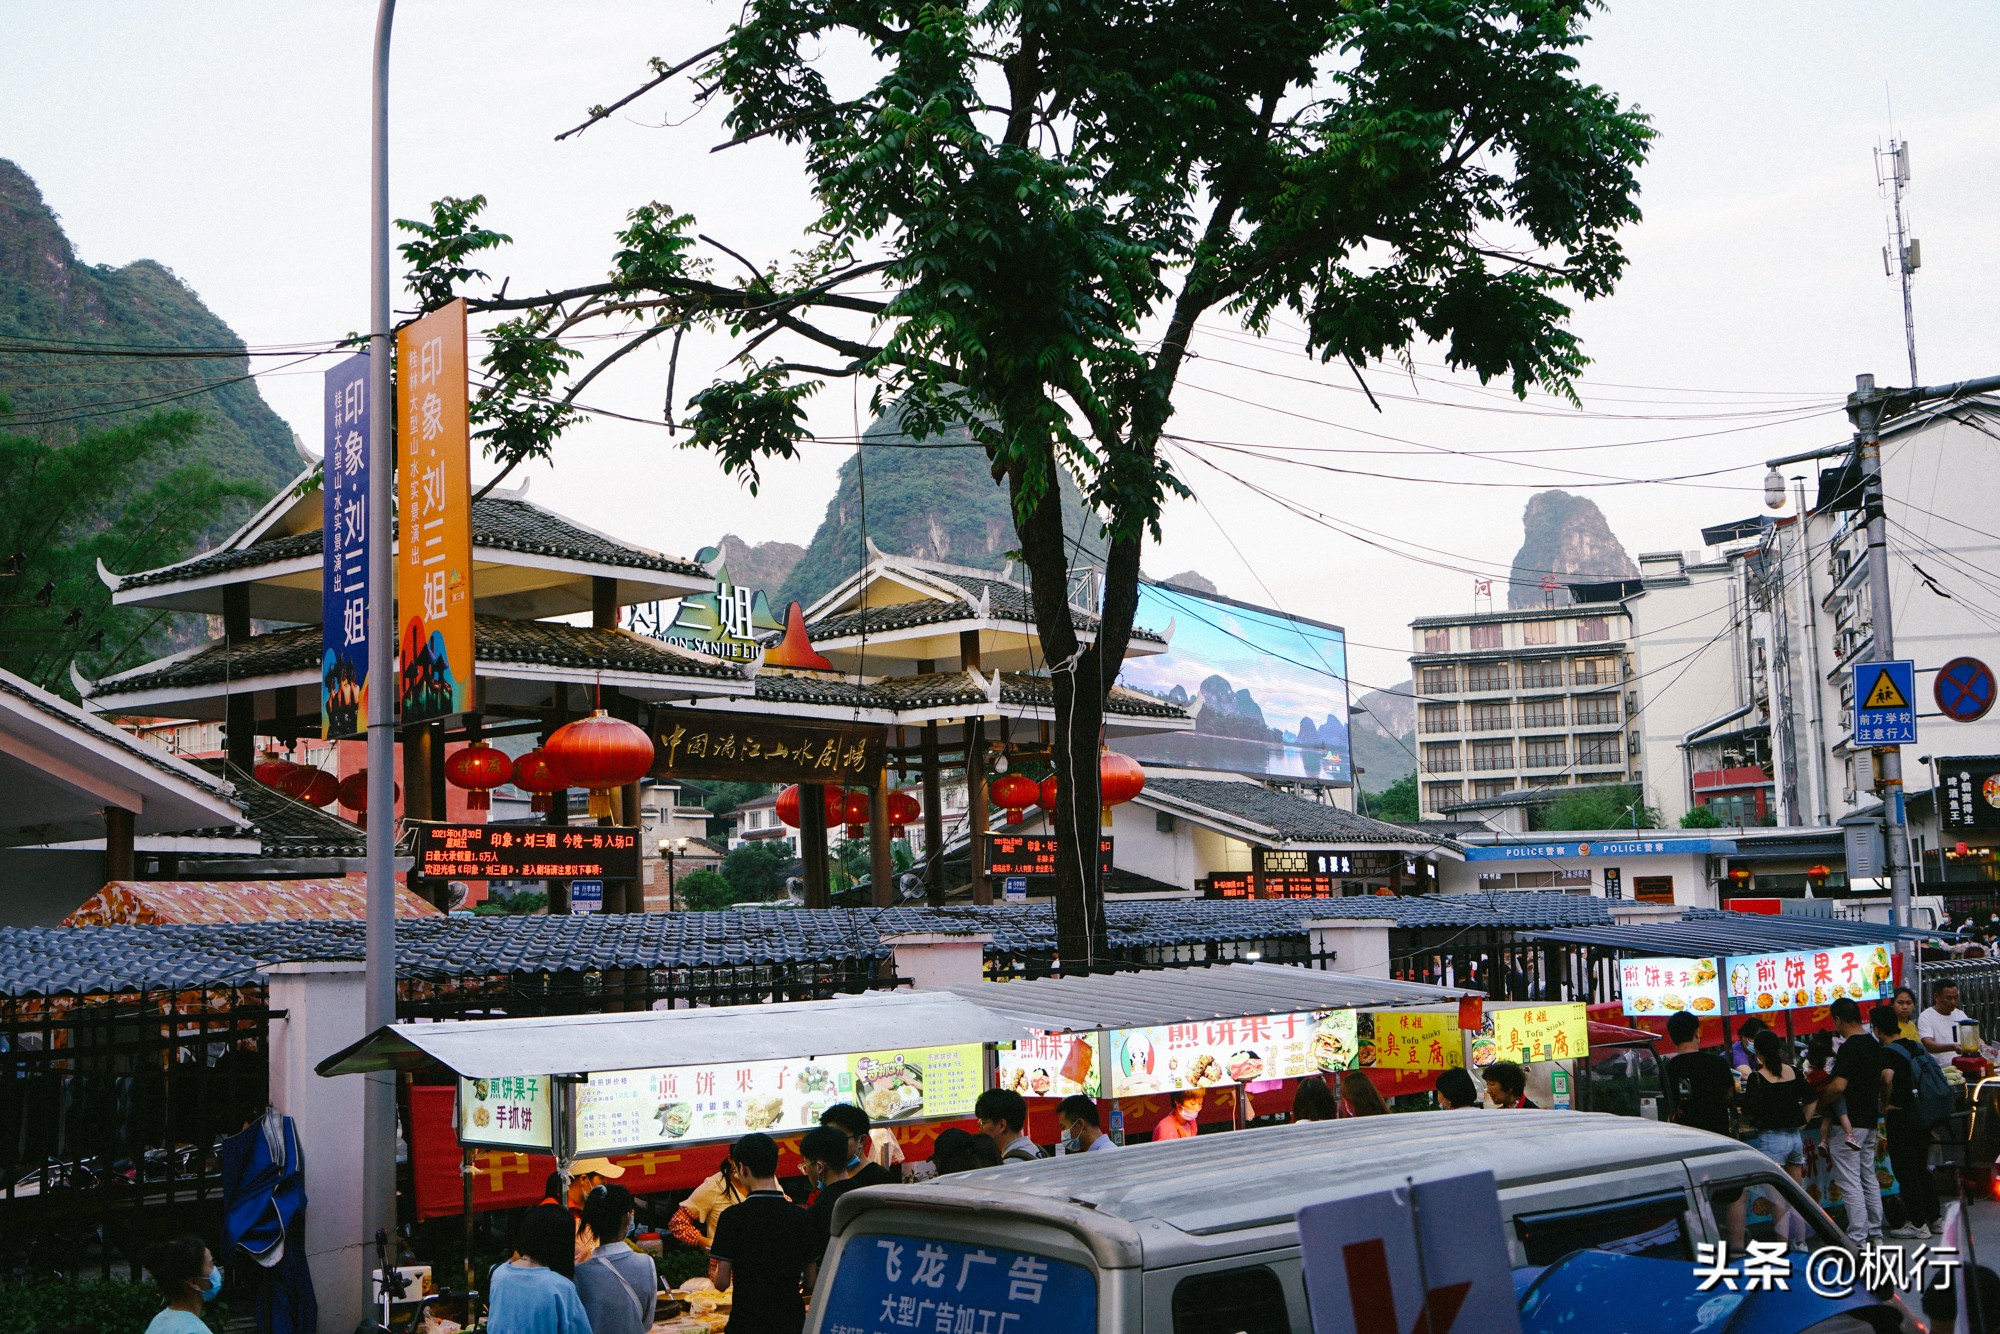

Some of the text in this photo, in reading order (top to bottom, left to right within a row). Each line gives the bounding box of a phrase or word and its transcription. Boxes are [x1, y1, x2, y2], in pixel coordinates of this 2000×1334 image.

[409, 350, 420, 565] 桂林大型山水实景演出
[333, 391, 343, 593] 桂林大型山水实景演出
[695, 637, 738, 658] SANJIE
[1859, 712, 1912, 726] 前方学校
[1860, 727, 1912, 740] 注意行人
[1947, 776, 1961, 820] 啤酒鱼王
[431, 829, 482, 839] 2021年04月30日
[562, 833, 603, 849] 今晚一场
[605, 835, 634, 849] 入场口
[1506, 846, 1566, 857] POLICE 警察
[1603, 843, 1665, 854] POLICE 警察
[1623, 964, 1690, 988] 煎饼果子
[1755, 951, 1859, 992] 煎饼果子
[1168, 1013, 1305, 1050] 煎饼果子
[1401, 1029, 1441, 1045] Tofu Stinky
[1525, 1020, 1566, 1038] Tofu Stinky
[1384, 1032, 1445, 1068] 臭豆腐
[1506, 1027, 1569, 1058] 臭豆腐
[490, 1077, 539, 1102] 煎饼果子
[658, 1066, 791, 1100] 煎饼果子
[496, 1105, 532, 1131] 手抓饼
[877, 1240, 1049, 1304] 飞龙广告
[879, 1294, 1021, 1334] 大型广告加工厂
